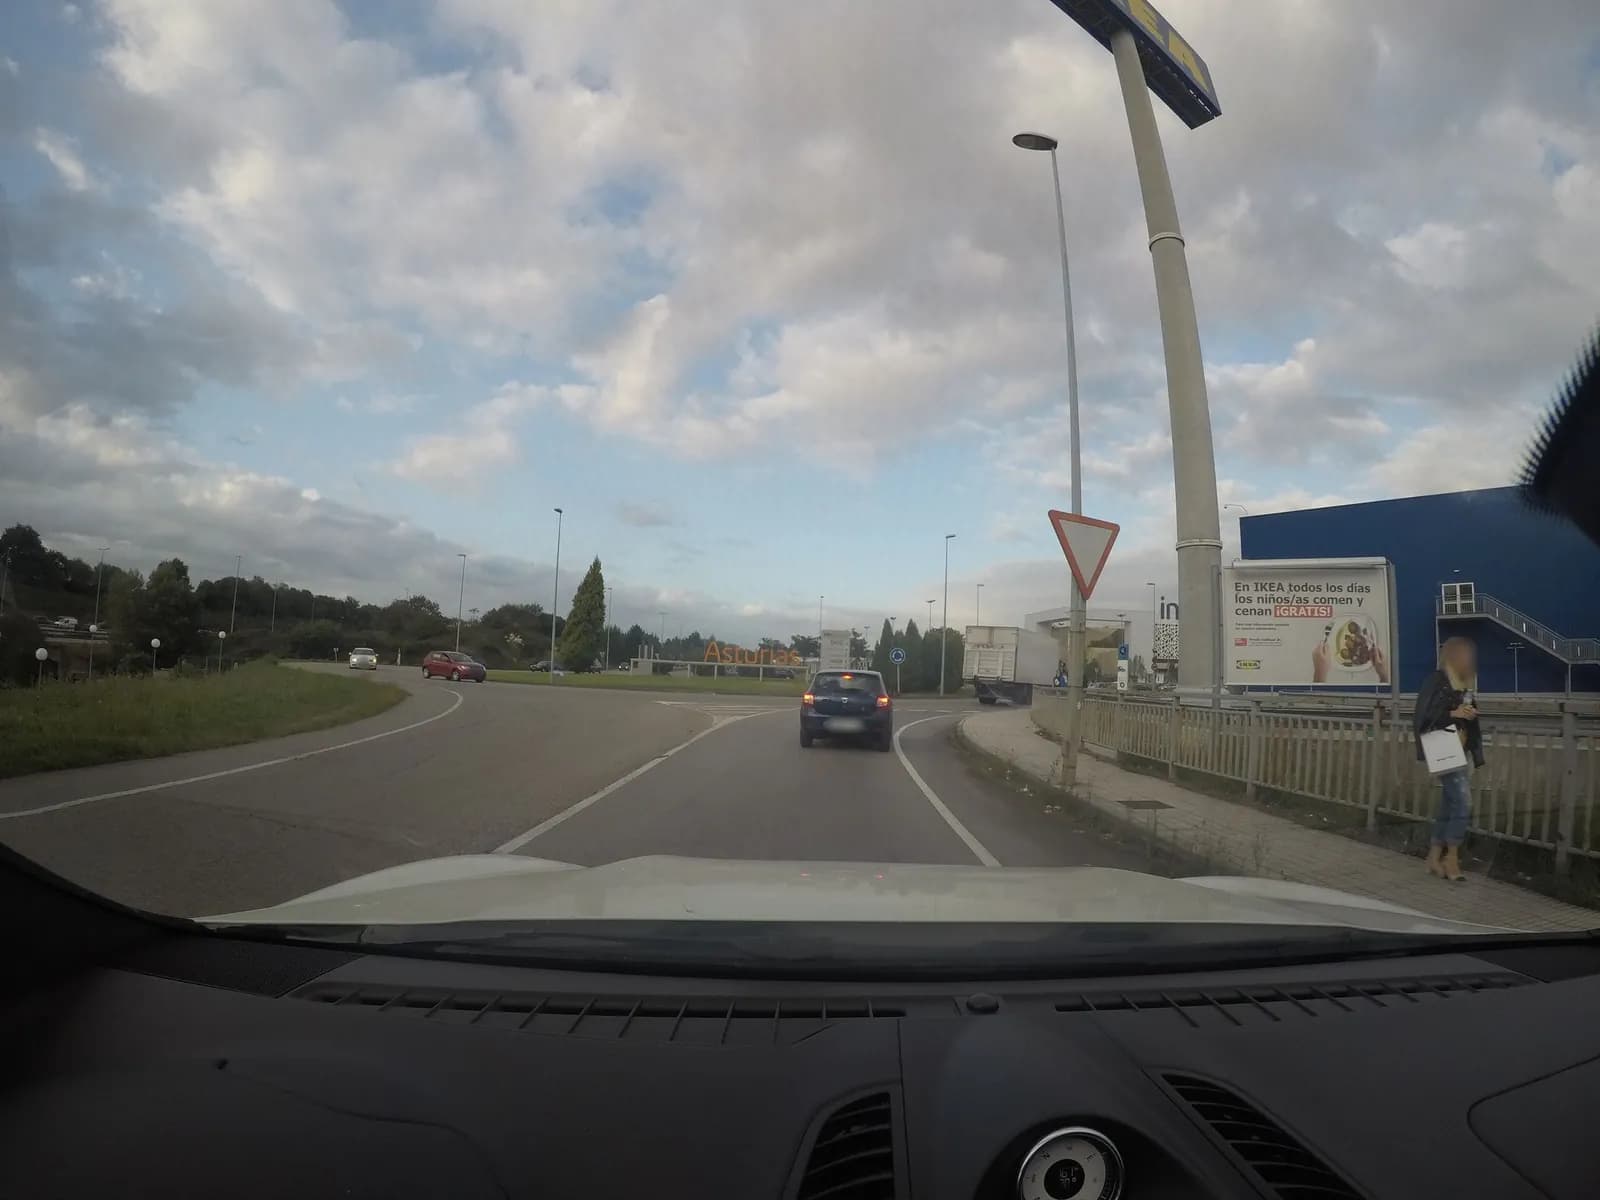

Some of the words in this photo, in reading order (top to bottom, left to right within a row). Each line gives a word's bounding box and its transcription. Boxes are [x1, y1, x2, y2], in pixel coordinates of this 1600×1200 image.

[1234, 582, 1250, 592] En
[1253, 582, 1285, 592] IKEA
[1288, 583, 1322, 593] todos
[1326, 583, 1343, 593] los
[1346, 583, 1371, 594] días
[1235, 594, 1253, 604] los
[1257, 594, 1309, 605] niños/as
[1313, 596, 1353, 604] comen
[1357, 597, 1364, 607] y
[1235, 607, 1272, 616] cenan
[1275, 606, 1332, 617] ¡GRATIS!
[704, 640, 801, 666] Asturias
